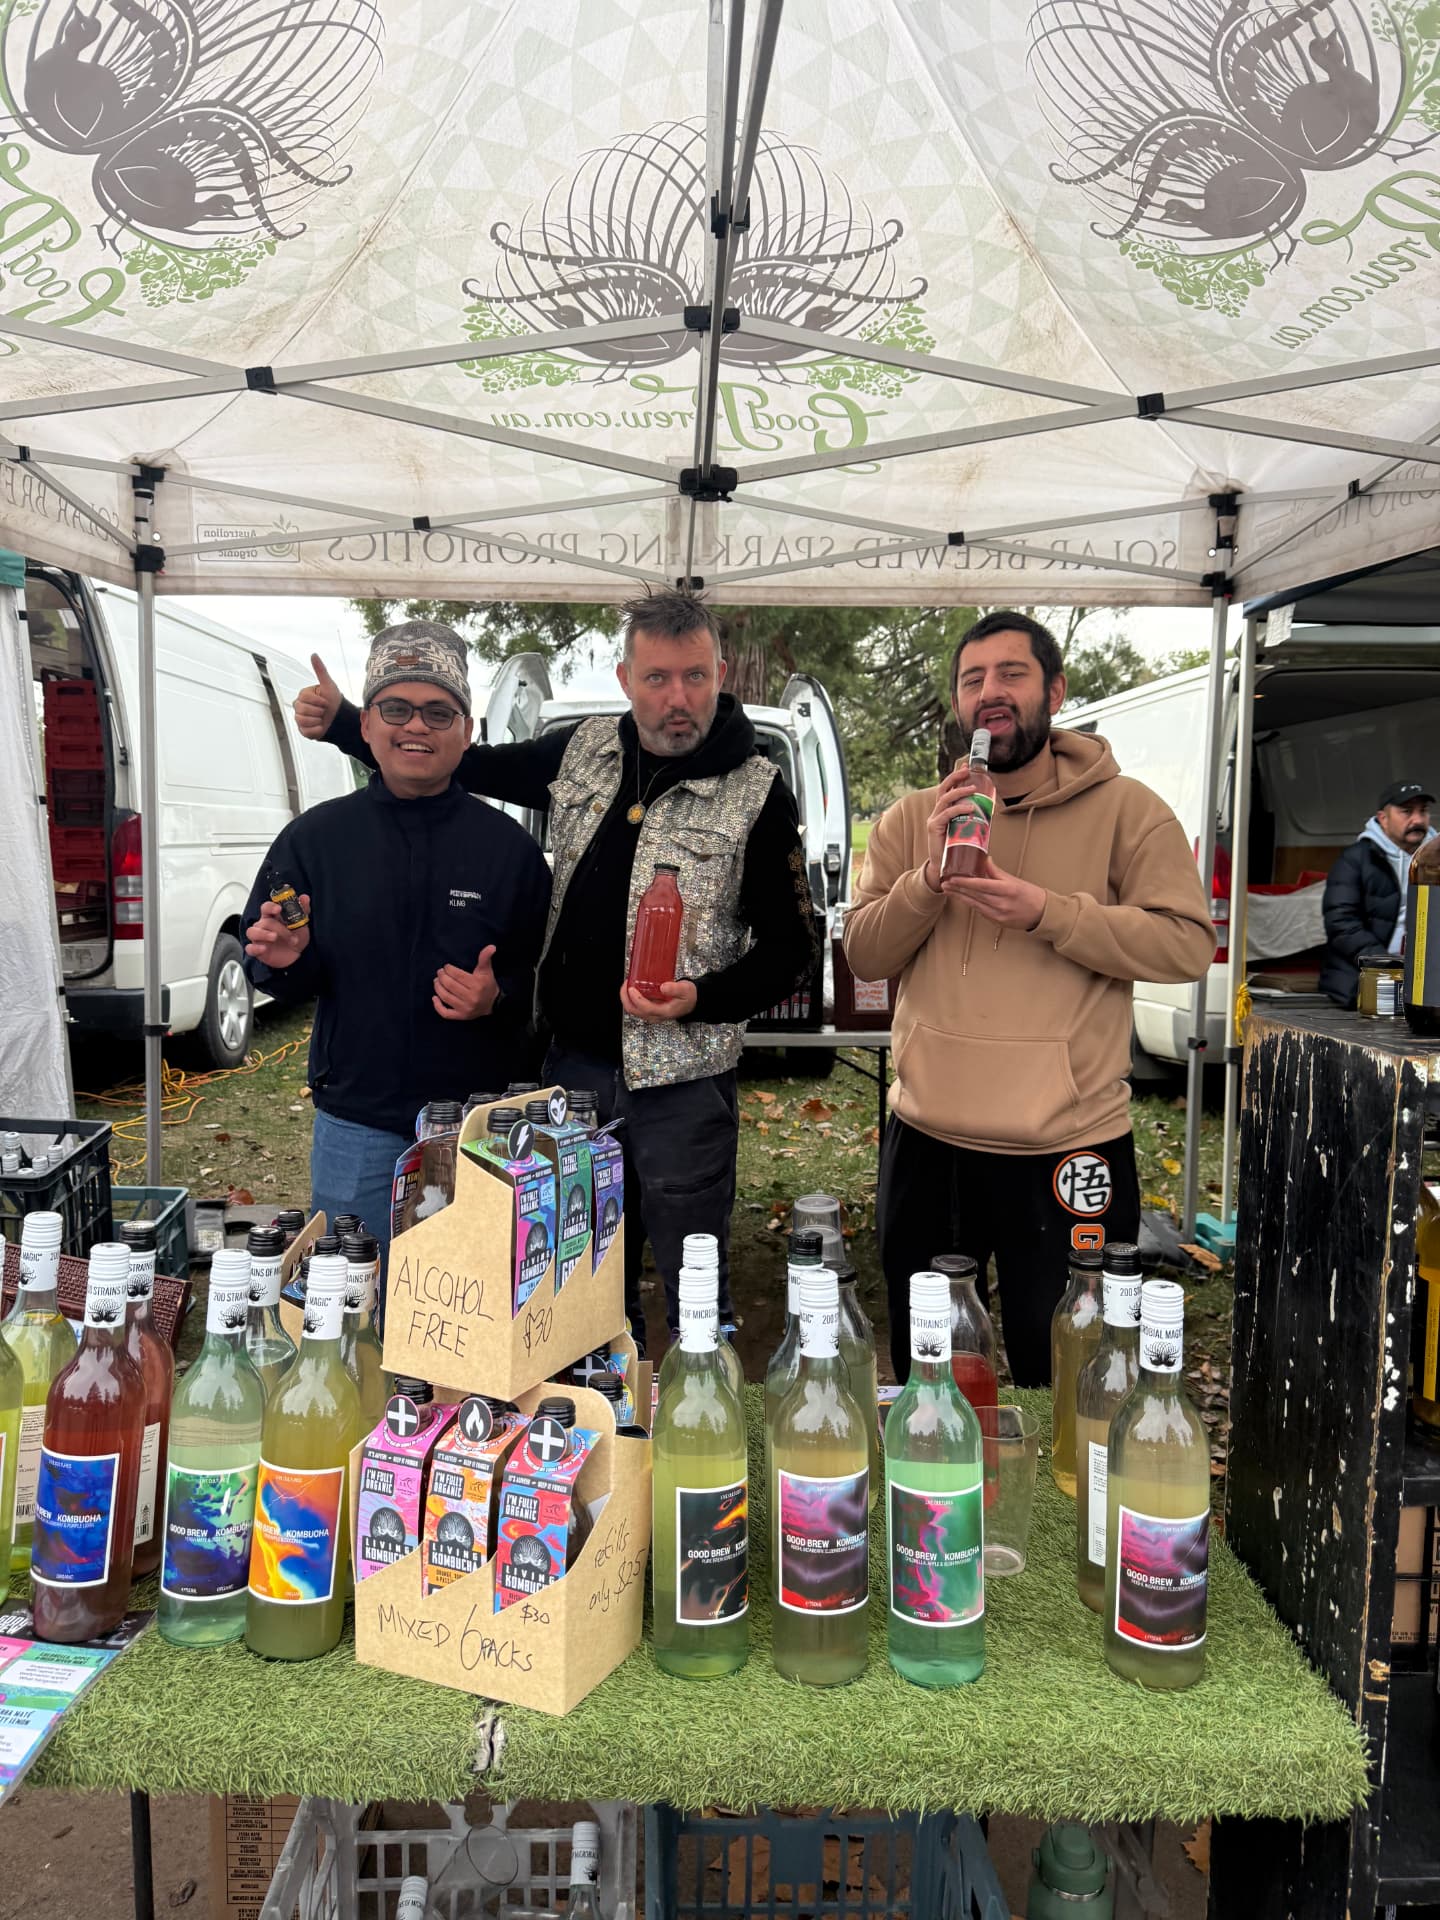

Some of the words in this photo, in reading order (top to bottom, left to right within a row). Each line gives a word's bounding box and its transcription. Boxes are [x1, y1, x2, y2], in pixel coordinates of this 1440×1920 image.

[1062, 1160, 1112, 1208] 悟
[92, 1285, 120, 1295] STRAINS
[213, 1291, 226, 1301] 200
[394, 1256, 494, 1321] ALCOHOL
[1120, 1287, 1132, 1297] 200
[917, 1318, 943, 1328] STRAINS
[408, 1310, 468, 1358] FREE
[523, 1307, 553, 1358] $30
[367, 1469, 376, 1479] I'M
[376, 1471, 393, 1483] FULLY
[435, 1471, 445, 1483] I'M
[445, 1474, 464, 1487] FULLY
[366, 1480, 393, 1494] ORGANIC
[434, 1482, 462, 1498] ORGANIC
[507, 1494, 517, 1505] I'M
[518, 1496, 537, 1509] FULLY
[57, 1514, 102, 1524] KOMBUCHA
[505, 1505, 537, 1521] ORGANIC
[169, 1524, 186, 1536] GOOD
[186, 1528, 209, 1537] BREW
[286, 1529, 330, 1538] KOMBUCHA
[366, 1537, 410, 1555] LIVING
[786, 1534, 806, 1547] GOOD
[807, 1539, 830, 1549] BREW
[366, 1547, 404, 1563] KOMBUC
[432, 1543, 478, 1561] LIVING
[687, 1550, 710, 1559] GOOD
[711, 1546, 731, 1558] BREW
[896, 1543, 914, 1557] GOOD
[915, 1550, 937, 1561] BREW
[944, 1545, 980, 1561] KOMBUCHA
[432, 1552, 478, 1573] KOMBUCHA
[506, 1565, 555, 1585] LIVING
[589, 1578, 610, 1612] only
[614, 1548, 646, 1603] $25
[1126, 1568, 1148, 1583] GOOD
[1149, 1575, 1174, 1587] BREW
[505, 1574, 545, 1593] KOMBUC
[519, 1602, 550, 1625] $30
[377, 1603, 451, 1648] MIXED
